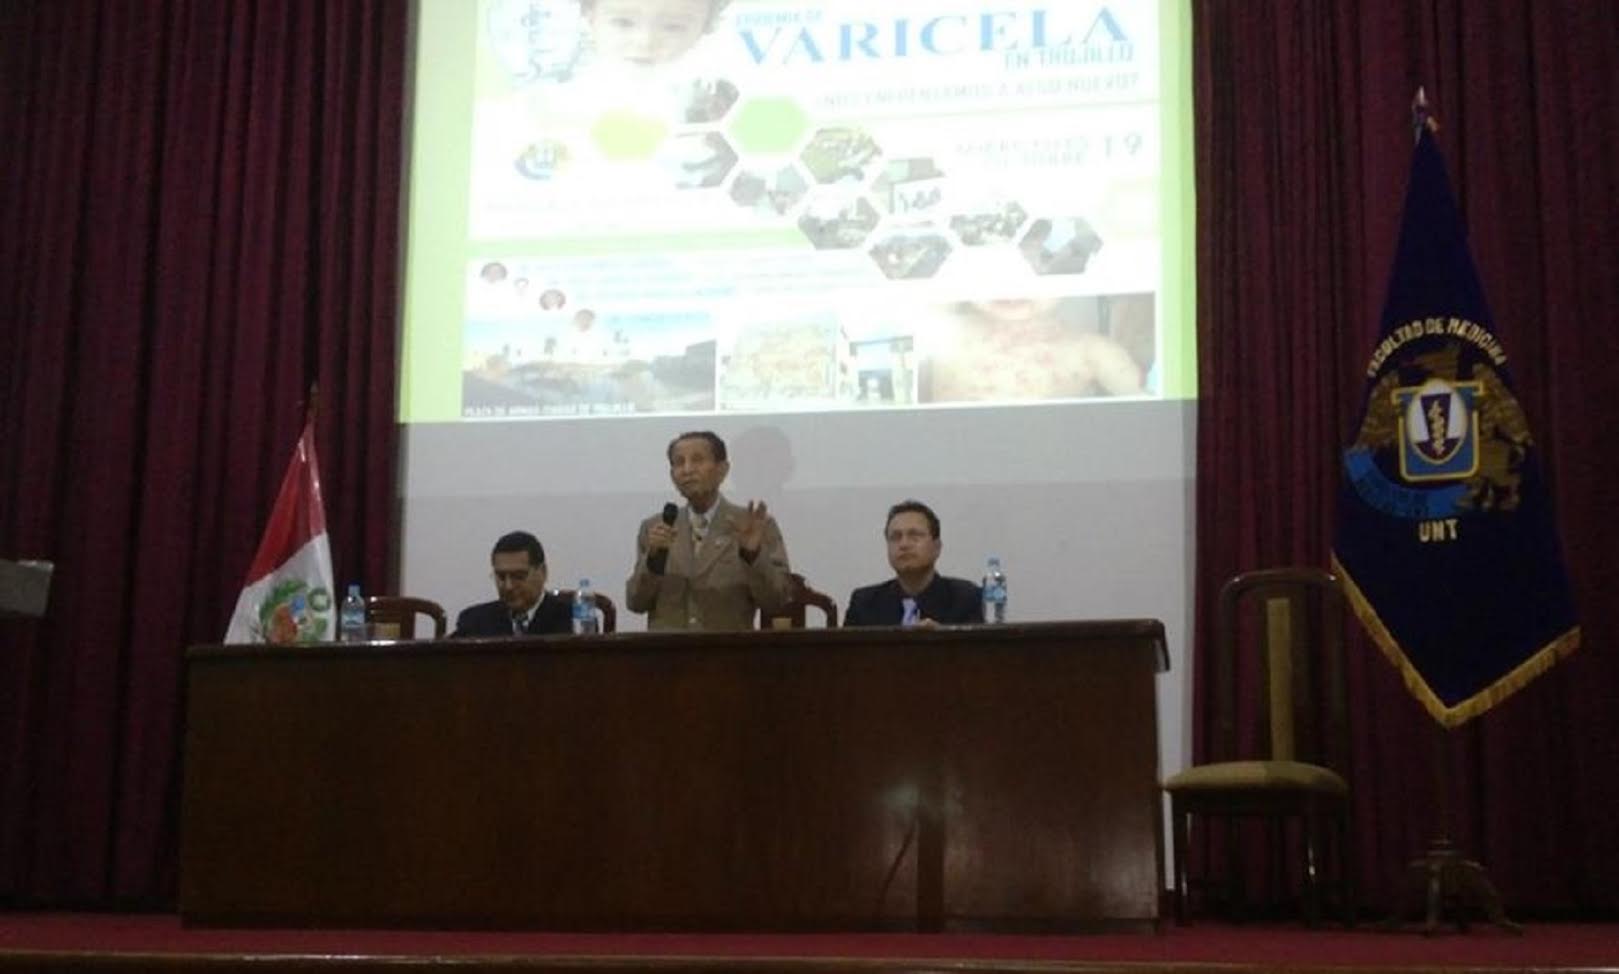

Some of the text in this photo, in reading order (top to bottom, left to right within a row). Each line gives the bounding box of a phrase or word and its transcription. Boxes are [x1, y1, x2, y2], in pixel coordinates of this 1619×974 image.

[738, 5, 1130, 65] VARICELA
[1367, 319, 1424, 378] FACULTAD
[1425, 317, 1445, 334] DE
[1419, 519, 1459, 543] UNT
